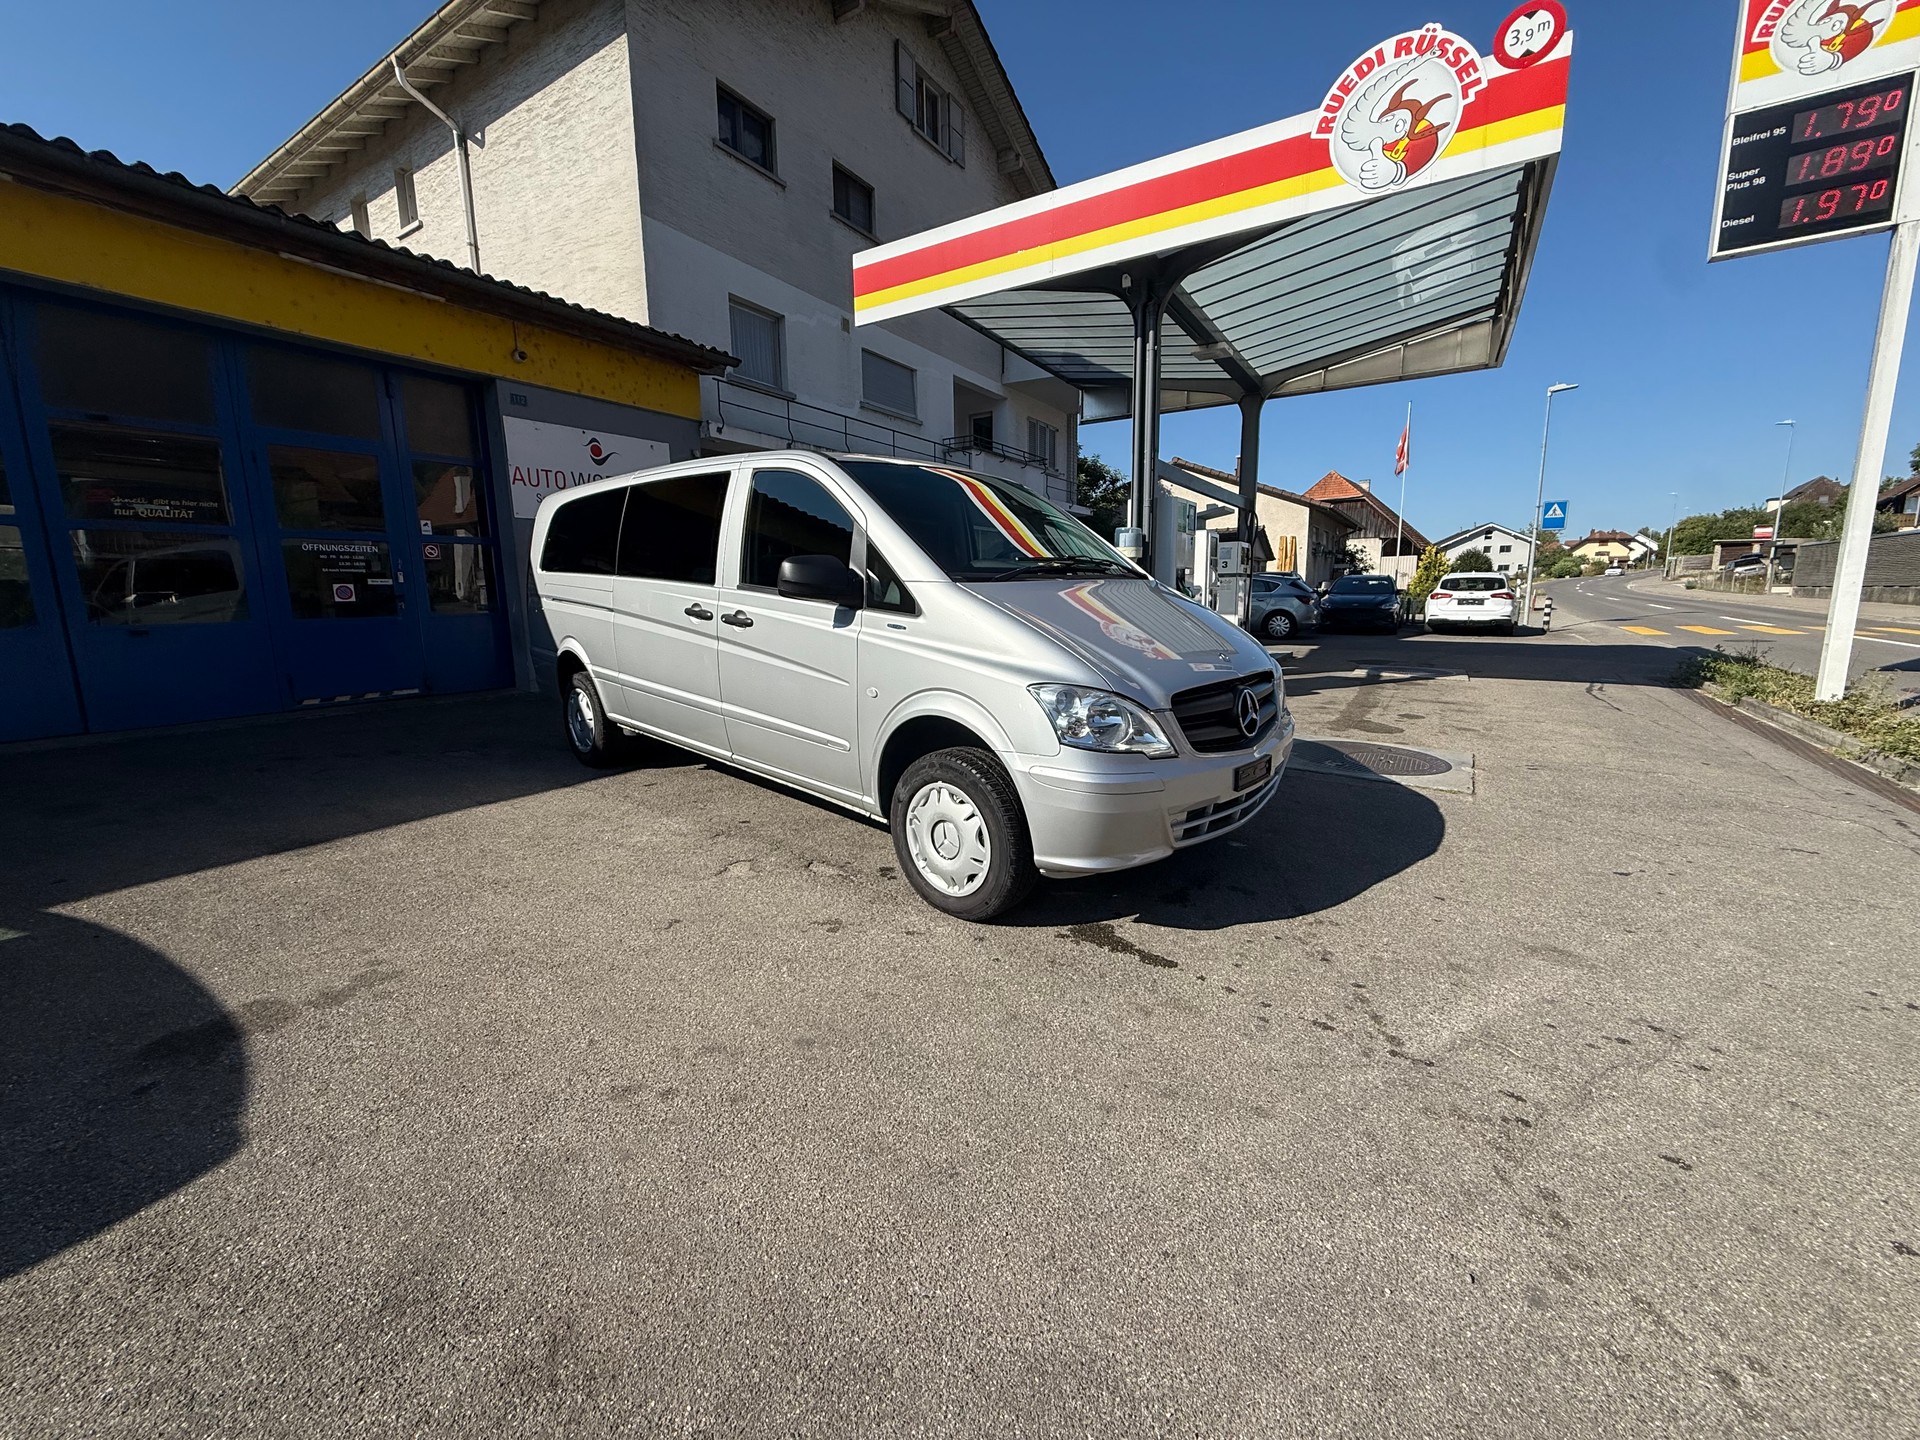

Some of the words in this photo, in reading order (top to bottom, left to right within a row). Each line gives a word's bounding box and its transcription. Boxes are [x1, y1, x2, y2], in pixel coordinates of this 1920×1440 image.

[1316, 48, 1385, 135] RUEDI
[1393, 27, 1483, 101] RÜSSEL
[1732, 129, 1771, 147] Bleifrei
[1773, 126, 1787, 137] 95
[1728, 167, 1761, 181] Super
[1726, 181, 1750, 192] Plus
[1752, 176, 1766, 185] 98
[1722, 215, 1755, 229] Diesel
[511, 465, 566, 490] AUTO
[114, 508, 135, 516] nur
[138, 508, 195, 519] QUALITÄT
[301, 542, 379, 553] ÖFFNUNGSZEITEN
[1221, 560, 1228, 569] 3
